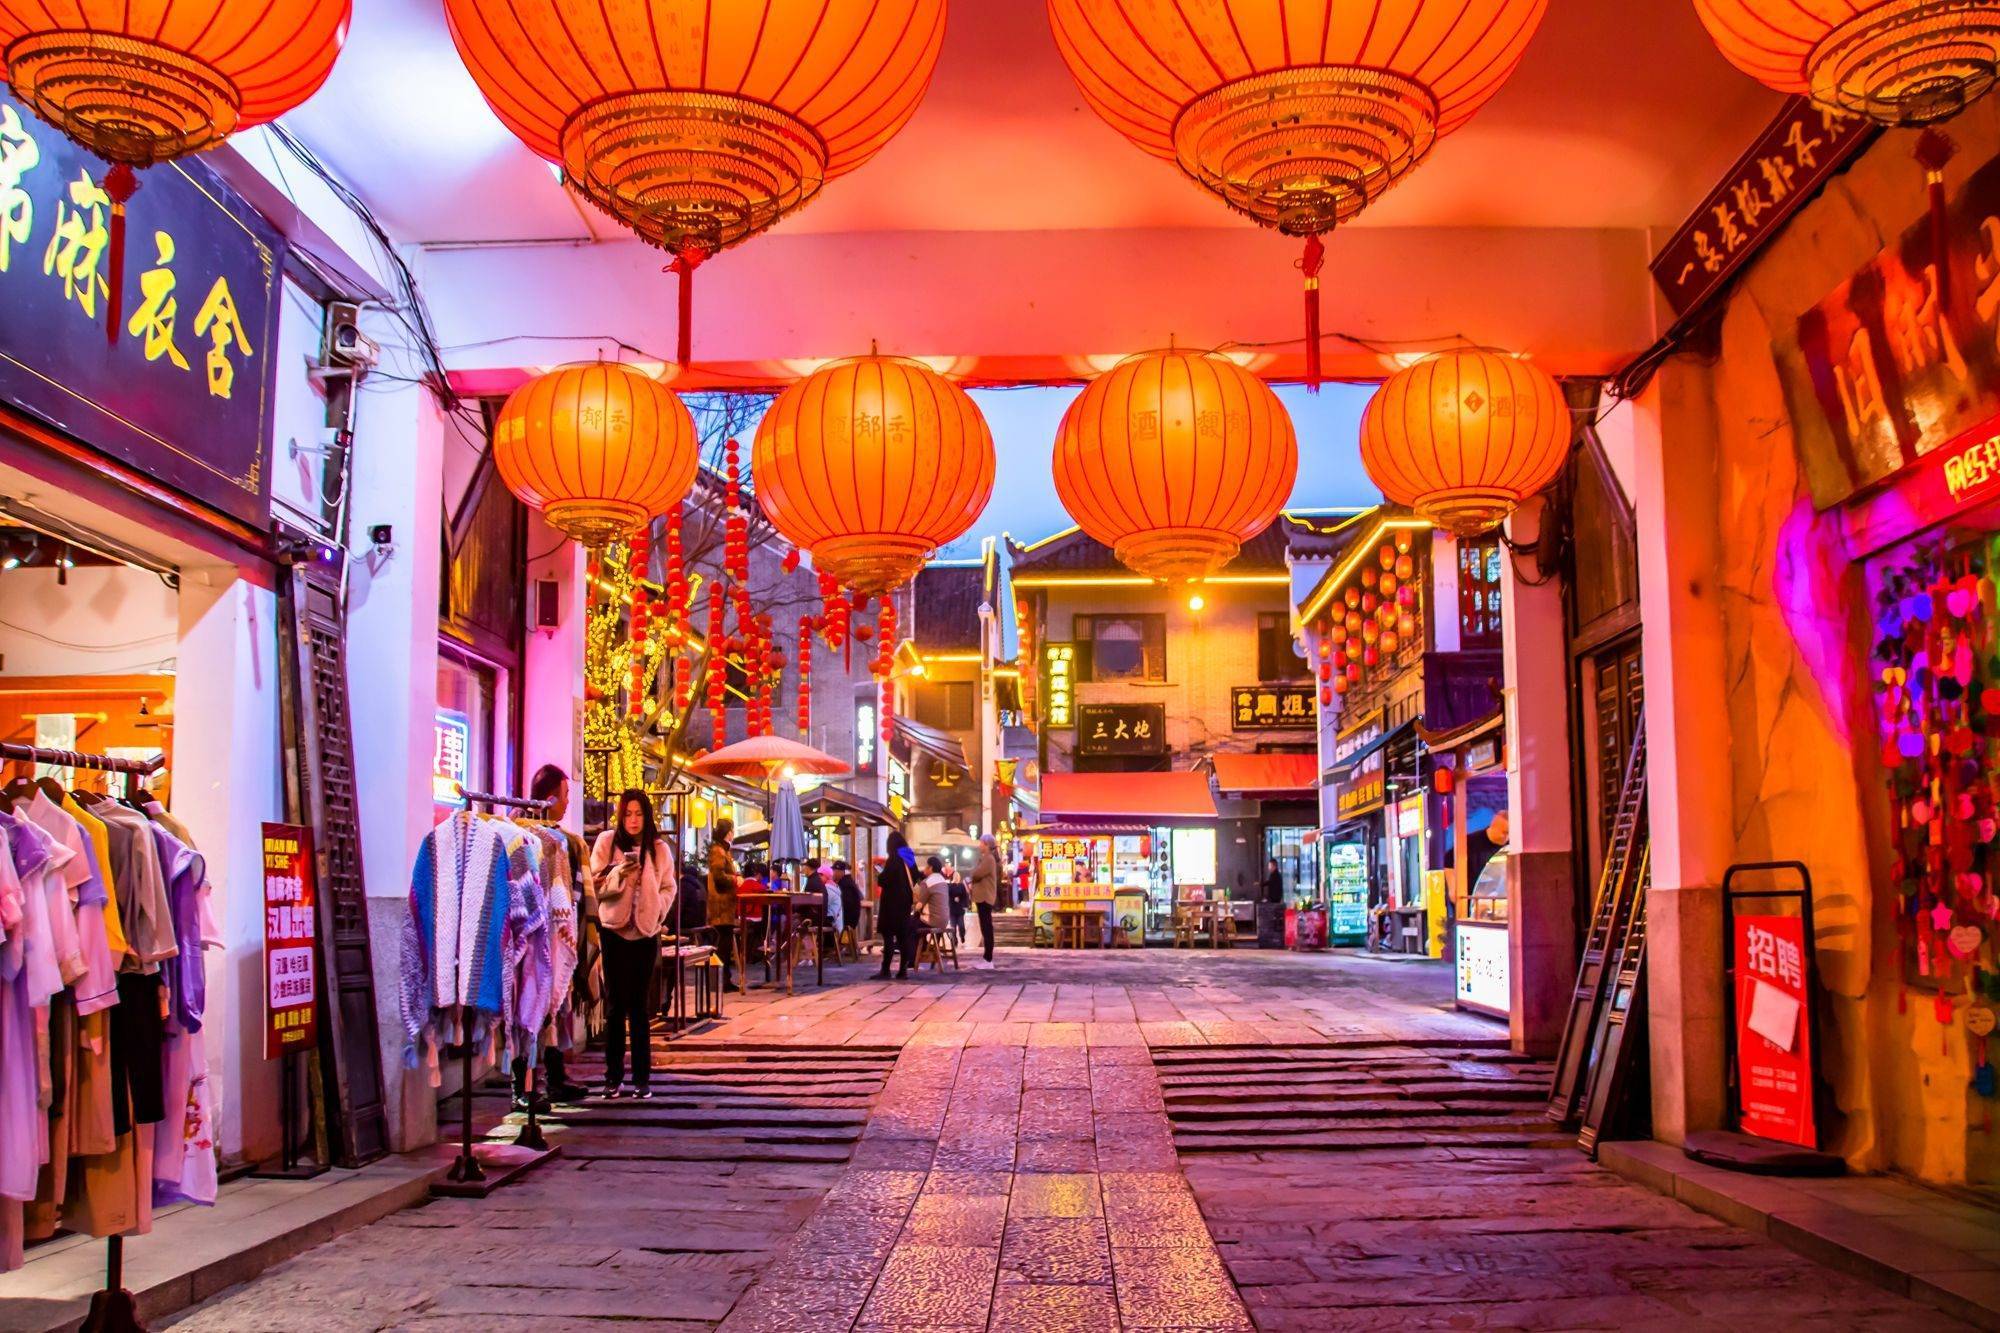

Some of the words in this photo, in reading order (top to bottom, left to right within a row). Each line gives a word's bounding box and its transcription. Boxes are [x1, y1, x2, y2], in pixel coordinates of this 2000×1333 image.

[1092, 719, 1151, 740] 三大炮
[1042, 841, 1087, 858] 岳阳鱼粉
[1747, 924, 1802, 989] 招聘
